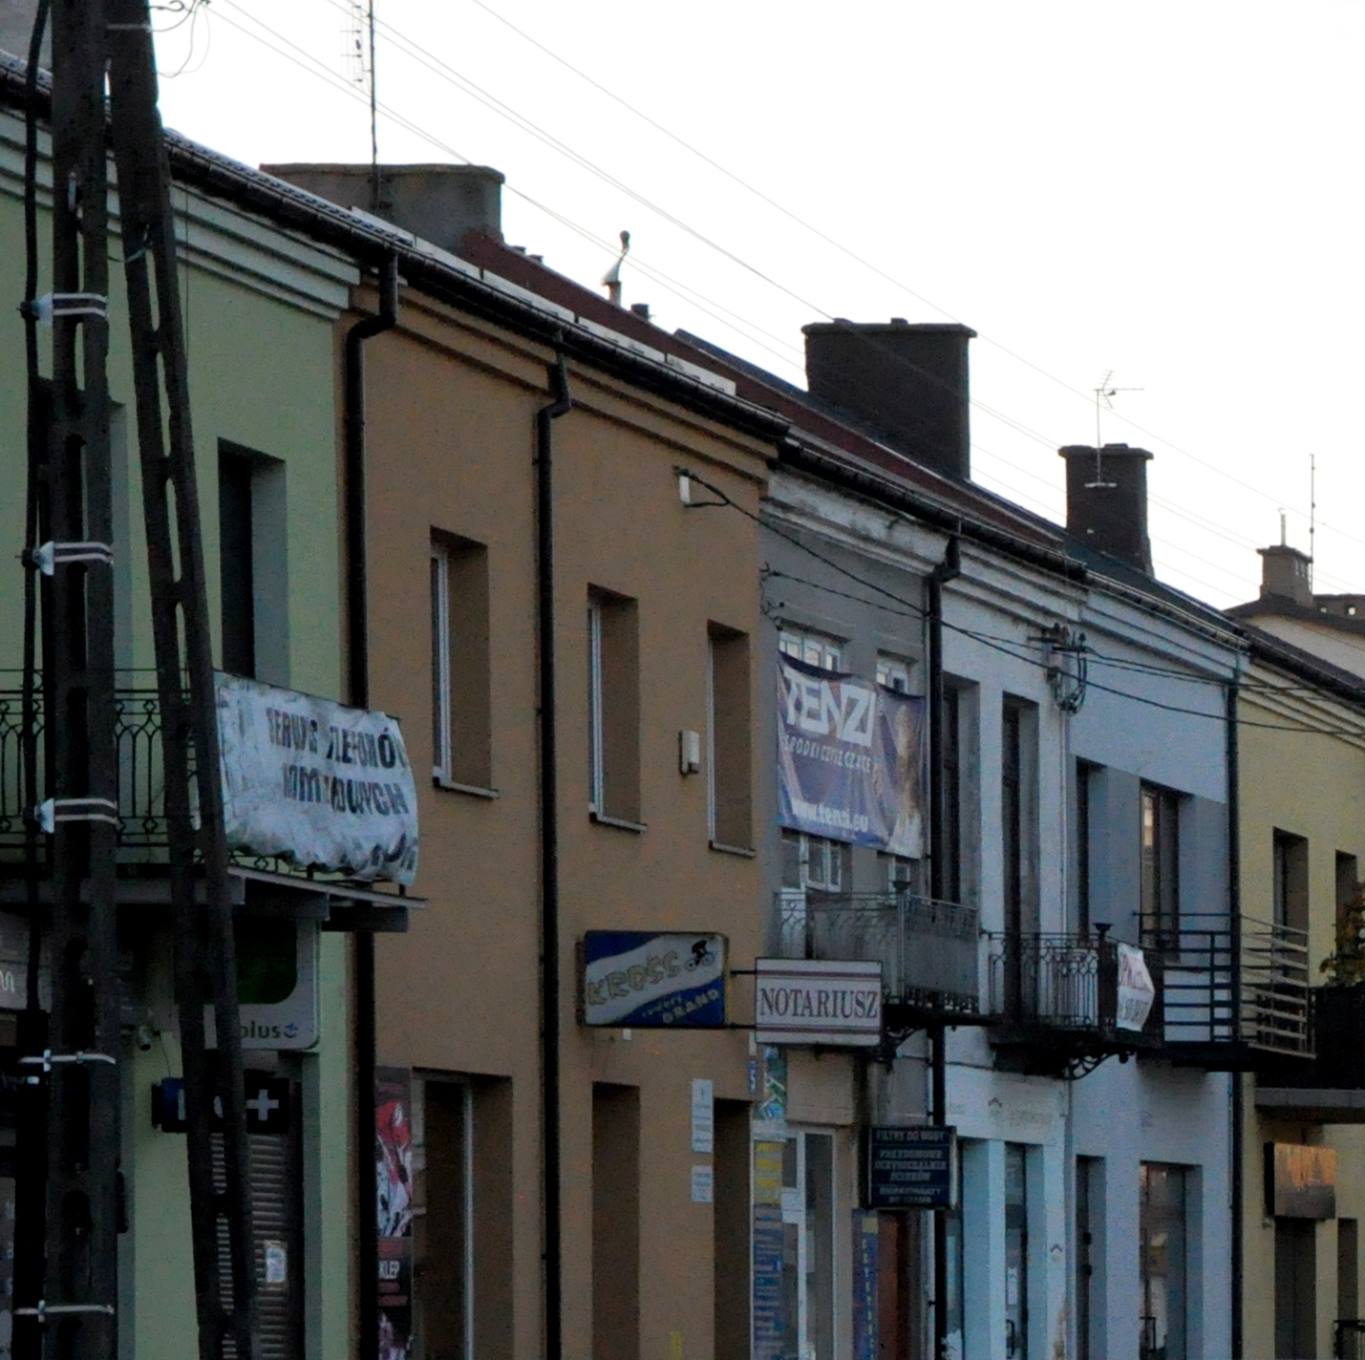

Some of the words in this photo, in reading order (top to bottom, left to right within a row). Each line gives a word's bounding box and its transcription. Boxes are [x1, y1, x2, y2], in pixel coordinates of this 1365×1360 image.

[783, 663, 877, 748] TENZI
[586, 951, 682, 1006] KROSS
[759, 988, 878, 1018] NOTARIUSZ
